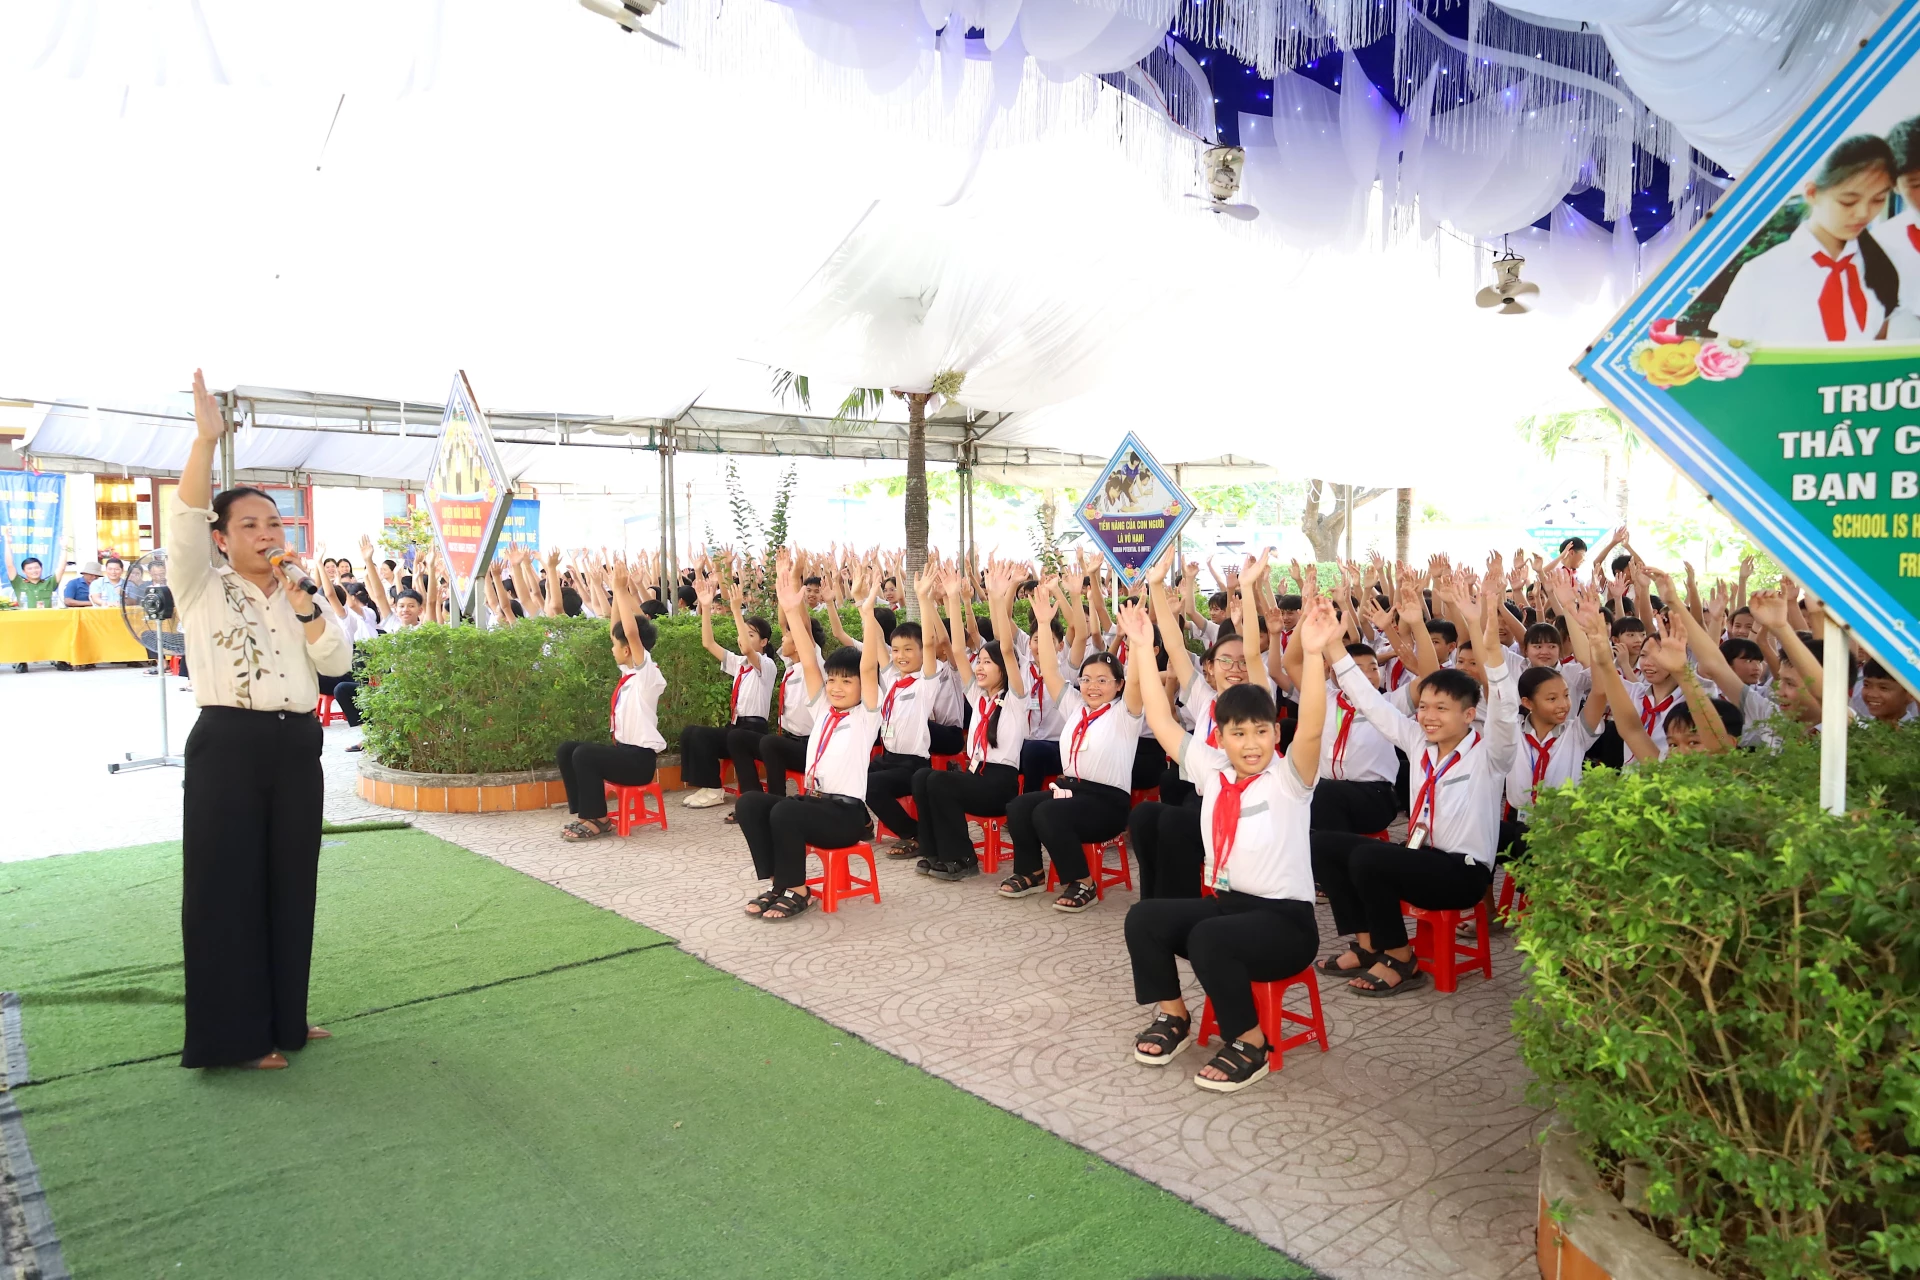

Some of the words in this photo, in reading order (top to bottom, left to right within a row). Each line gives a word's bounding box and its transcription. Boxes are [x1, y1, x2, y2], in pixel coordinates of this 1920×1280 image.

[1778, 419, 1881, 459] THẦY
[1894, 425, 1920, 455] C
[1792, 471, 1877, 506] BẠN
[1891, 471, 1918, 500] B
[1111, 519, 1125, 531] NĂNG
[1126, 518, 1136, 530] CỦA
[1137, 520, 1148, 530] CON
[1149, 517, 1165, 529] NGƯỜI
[1832, 513, 1889, 539] SCHOOL
[1892, 513, 1909, 539] IS
[1118, 533, 1123, 543] LÀ
[1125, 533, 1131, 543] VÔ
[1132, 533, 1144, 544] HẠN!
